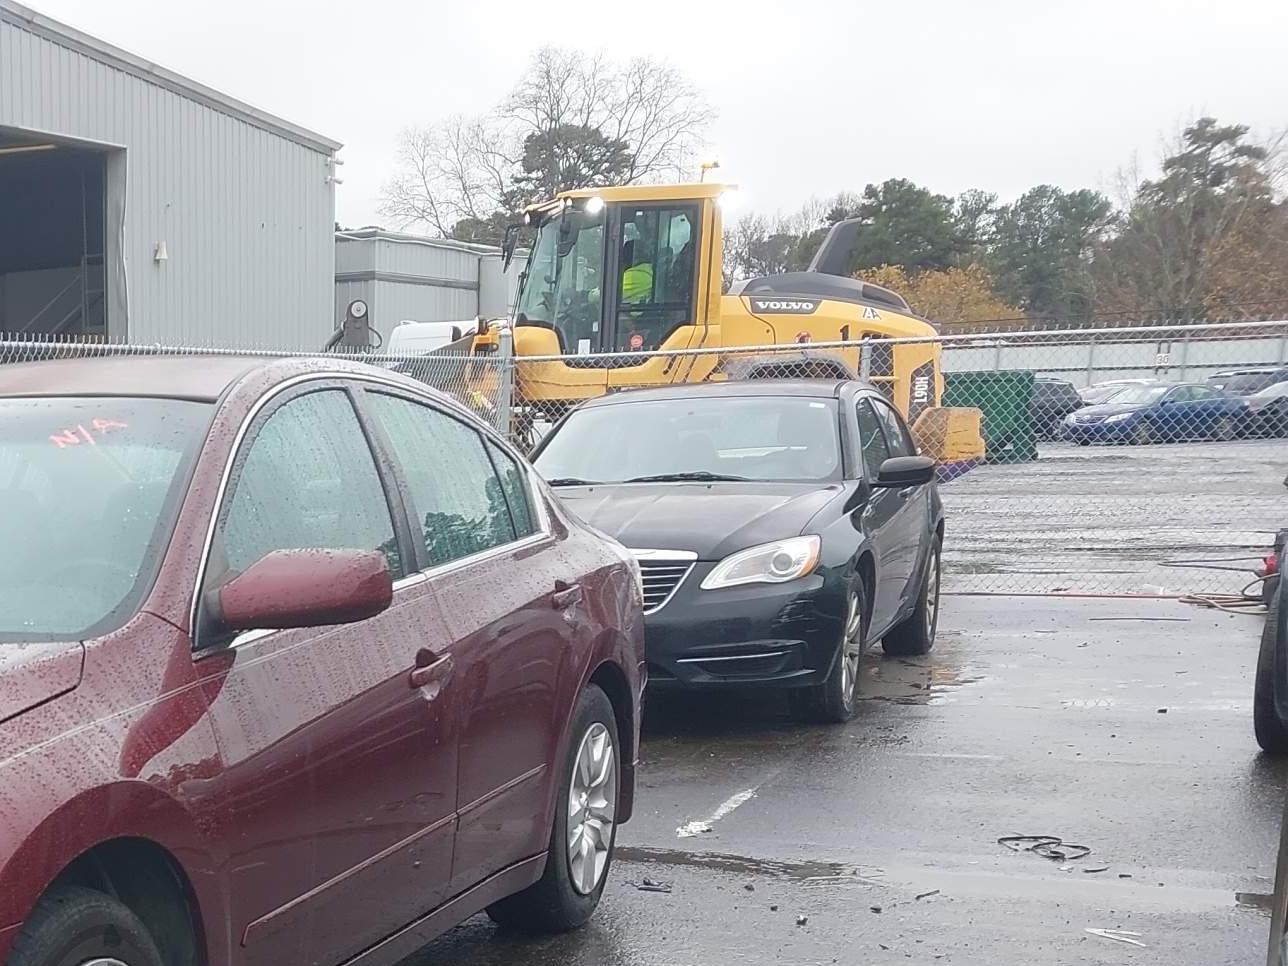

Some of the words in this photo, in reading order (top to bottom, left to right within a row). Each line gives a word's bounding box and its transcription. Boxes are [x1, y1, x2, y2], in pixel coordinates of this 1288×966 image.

[755, 301, 814, 310] VOLVO
[914, 376, 929, 402] L90H
[49, 418, 128, 448] N/A
